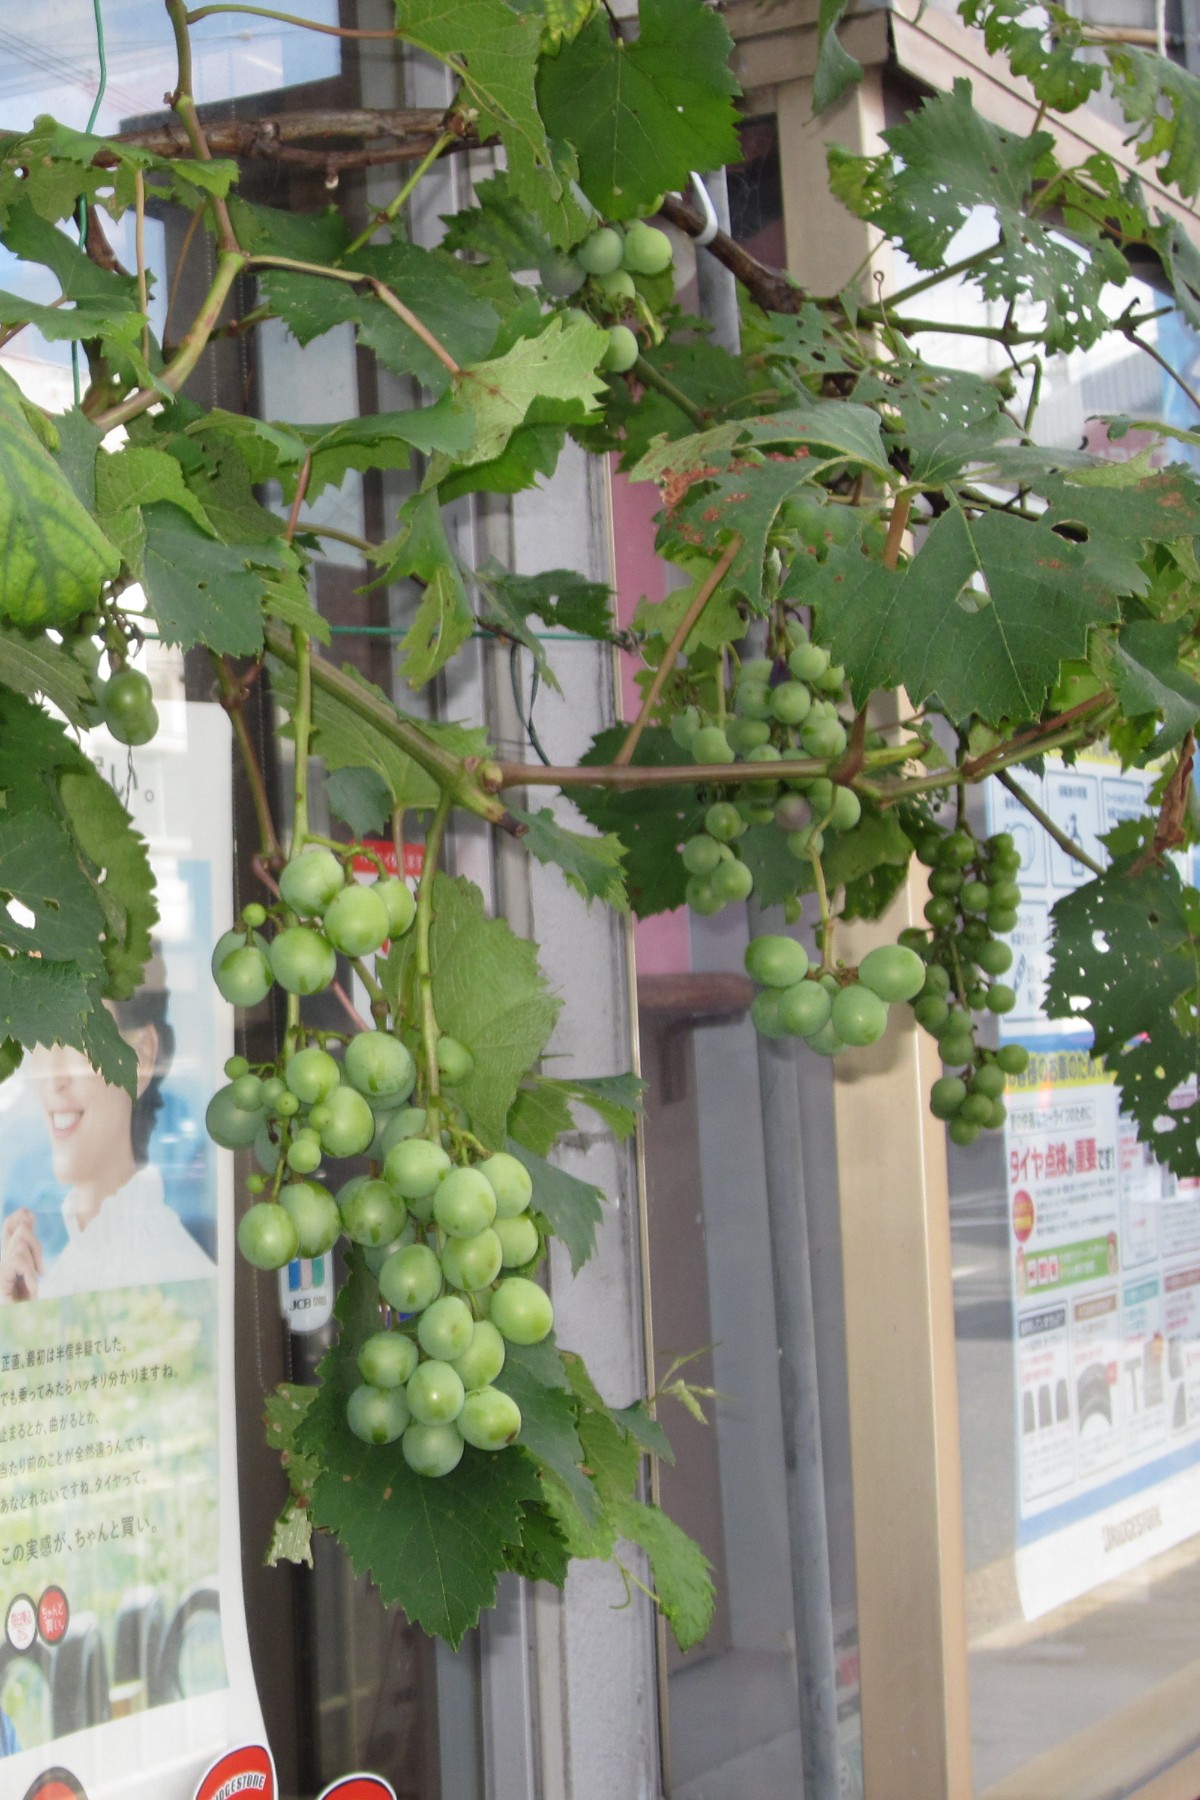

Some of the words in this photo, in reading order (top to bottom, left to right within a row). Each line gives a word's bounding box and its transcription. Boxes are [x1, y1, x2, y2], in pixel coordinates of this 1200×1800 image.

[289, 1297, 311, 1312] JCB
[0, 1336, 127, 1373] 正直、最初は半信半疑でした。
[0, 1363, 179, 1407] でも乗ってみたらハッキリ分かりますね。
[0, 1434, 150, 1479] 当たり前のことが全然違うんです。
[0, 1470, 147, 1515] あなどれないですね、タイヤって。
[2, 1515, 157, 1566] この実感が、ちゃんと買い。
